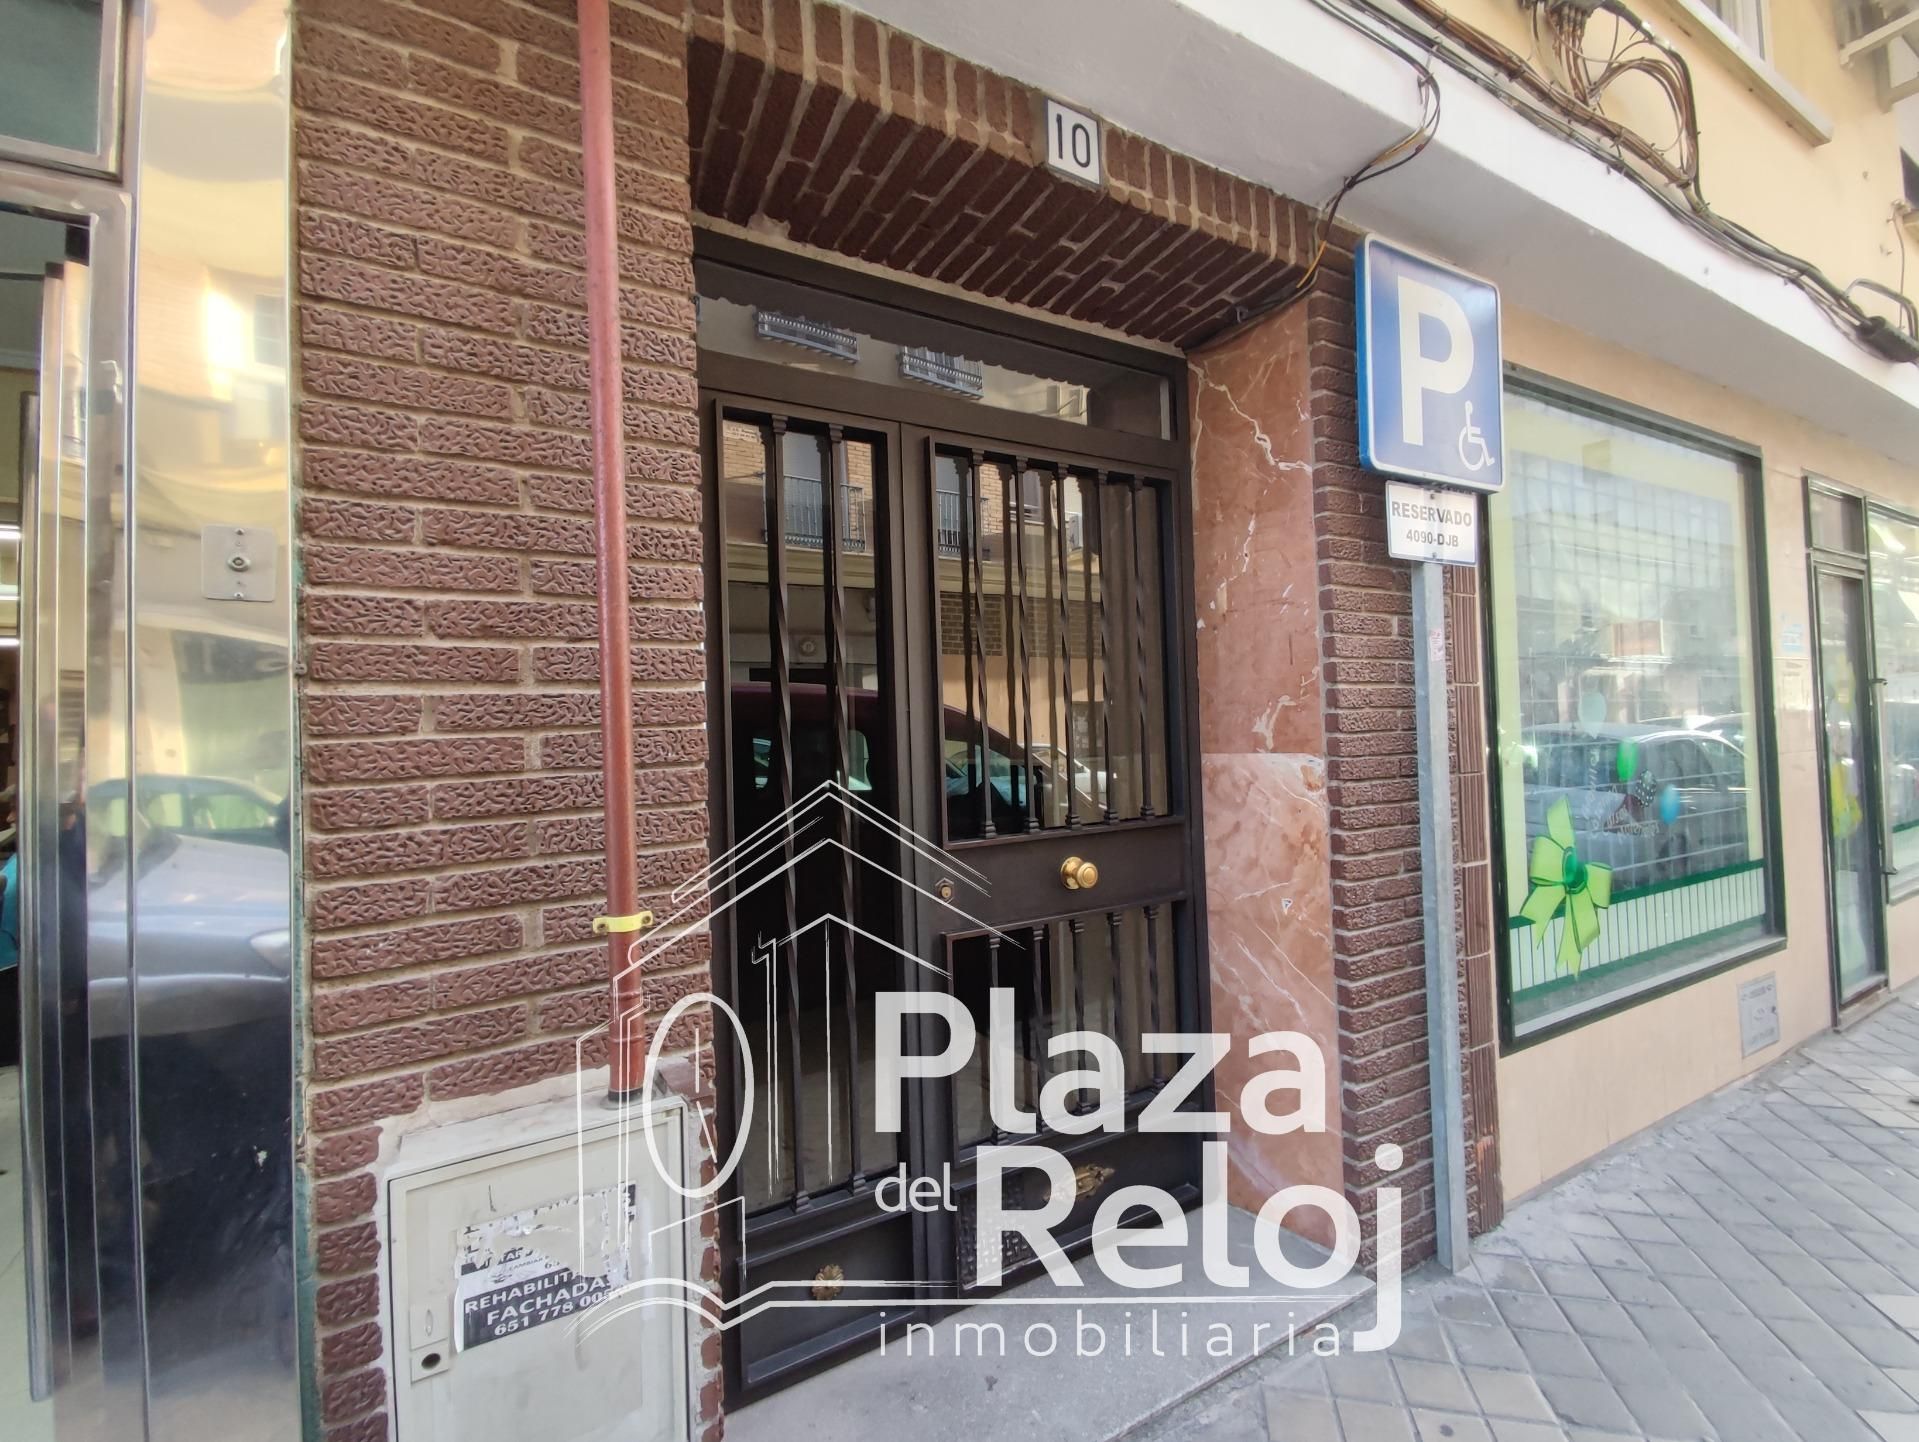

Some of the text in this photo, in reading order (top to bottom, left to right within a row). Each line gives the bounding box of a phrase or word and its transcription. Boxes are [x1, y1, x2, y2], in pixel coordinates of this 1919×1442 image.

[1056, 113, 1091, 168] 10
[1397, 275, 1474, 446] P
[1391, 501, 1473, 528] RESERVADO
[1406, 529, 1460, 548] 4090-DJB
[487, 1277, 611, 1326] FACHADA
[494, 1316, 529, 1336] 651
[538, 1301, 574, 1321] 778
